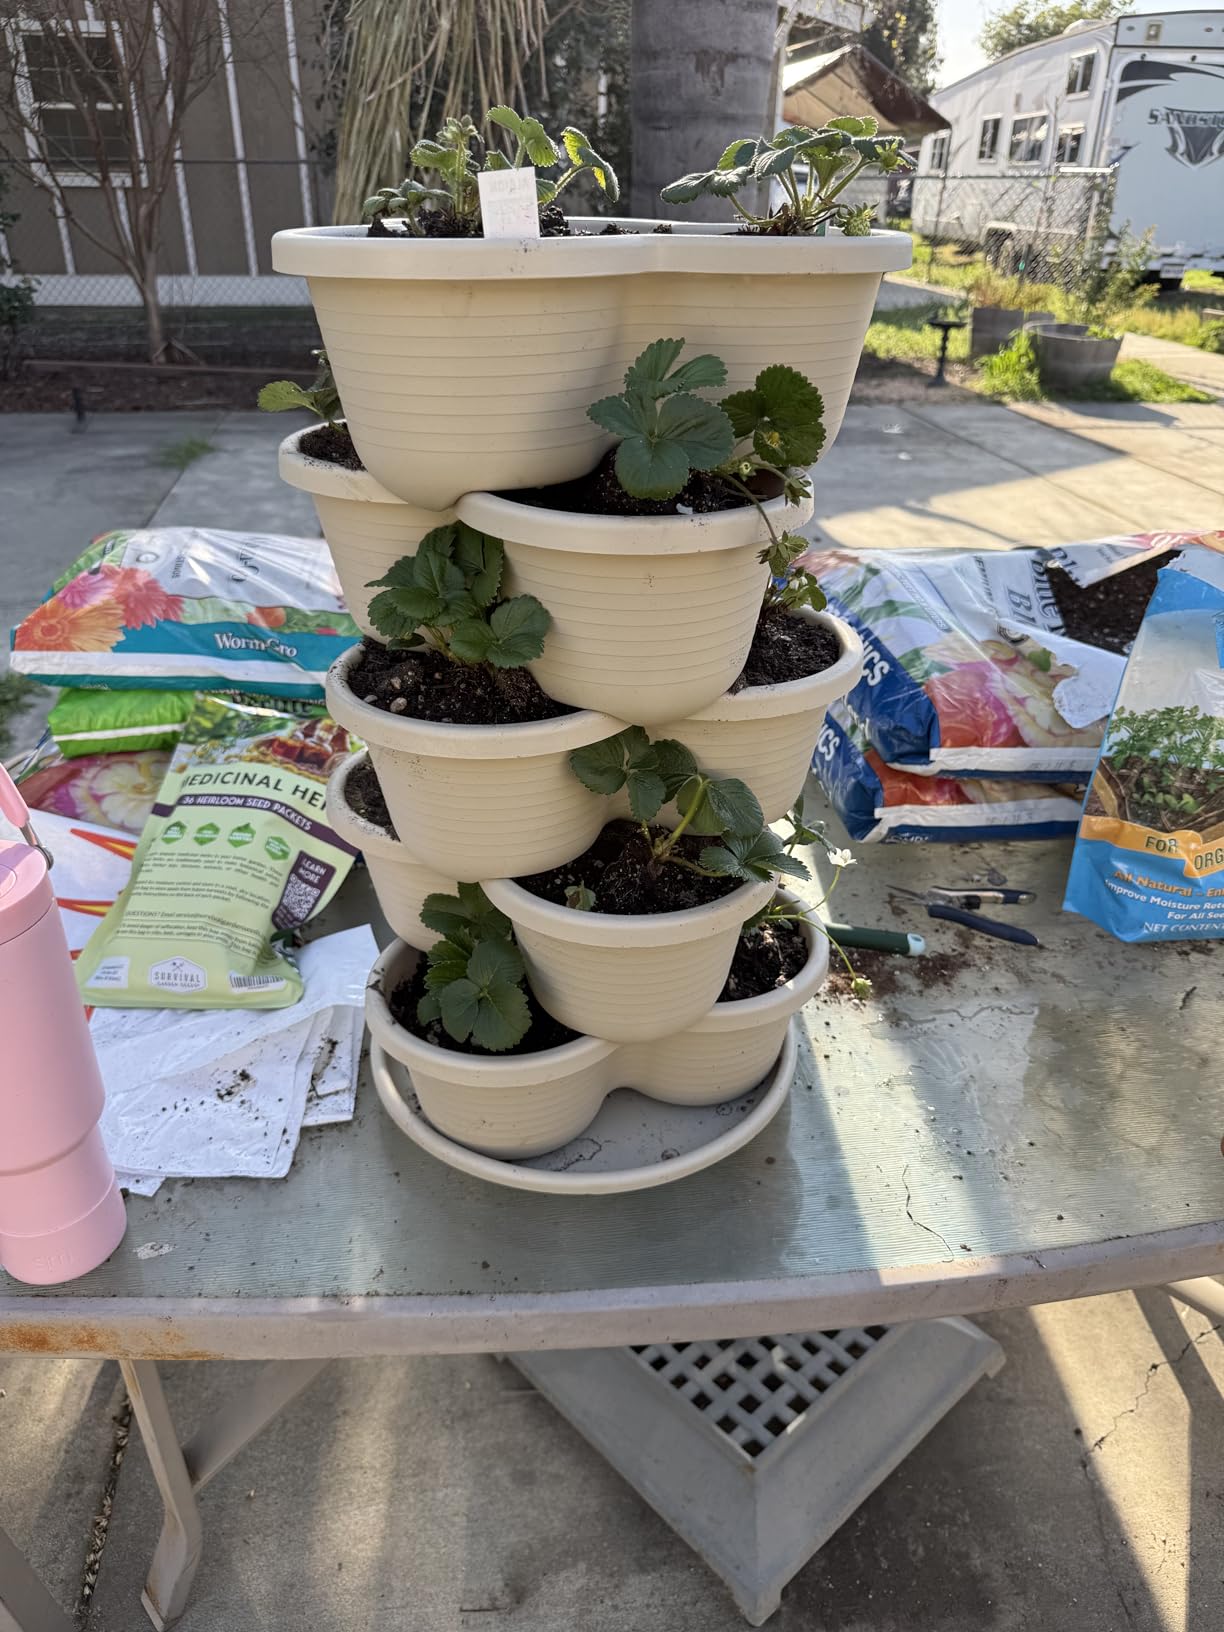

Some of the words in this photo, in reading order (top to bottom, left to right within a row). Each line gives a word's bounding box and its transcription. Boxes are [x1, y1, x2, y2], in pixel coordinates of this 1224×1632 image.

[183, 796, 194, 804] 36
[196, 796, 244, 806] HEIRLOOM
[246, 798, 272, 809] SEED
[272, 803, 313, 832] PACKETS
[1145, 836, 1178, 854] FOR
[298, 867, 321, 884] MORE
[302, 858, 327, 876] LEARN
[1136, 877, 1193, 898] Natural
[1149, 896, 1201, 911] Moisture
[1167, 911, 1187, 920] For
[1189, 911, 1205, 920] All
[1144, 922, 1168, 934] NET
[154, 971, 201, 983] SURVIVAL
